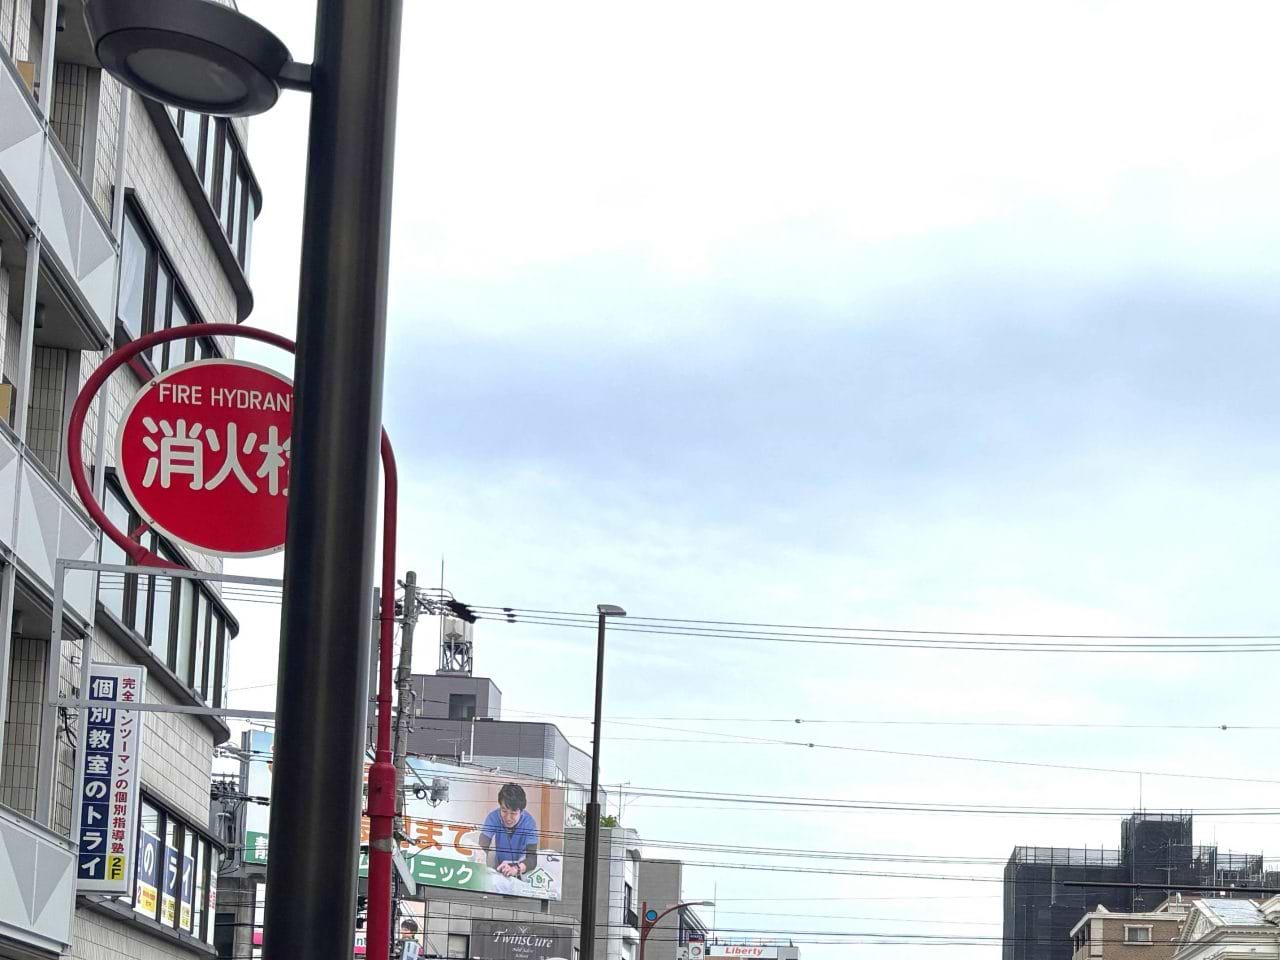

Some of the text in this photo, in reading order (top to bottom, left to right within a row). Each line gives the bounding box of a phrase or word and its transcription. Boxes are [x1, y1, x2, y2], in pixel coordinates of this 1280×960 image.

[159, 383, 294, 412] FIRE HYDRAN
[81, 677, 117, 877] 個別教室のトライ
[725, 946, 764, 957] Liberty
